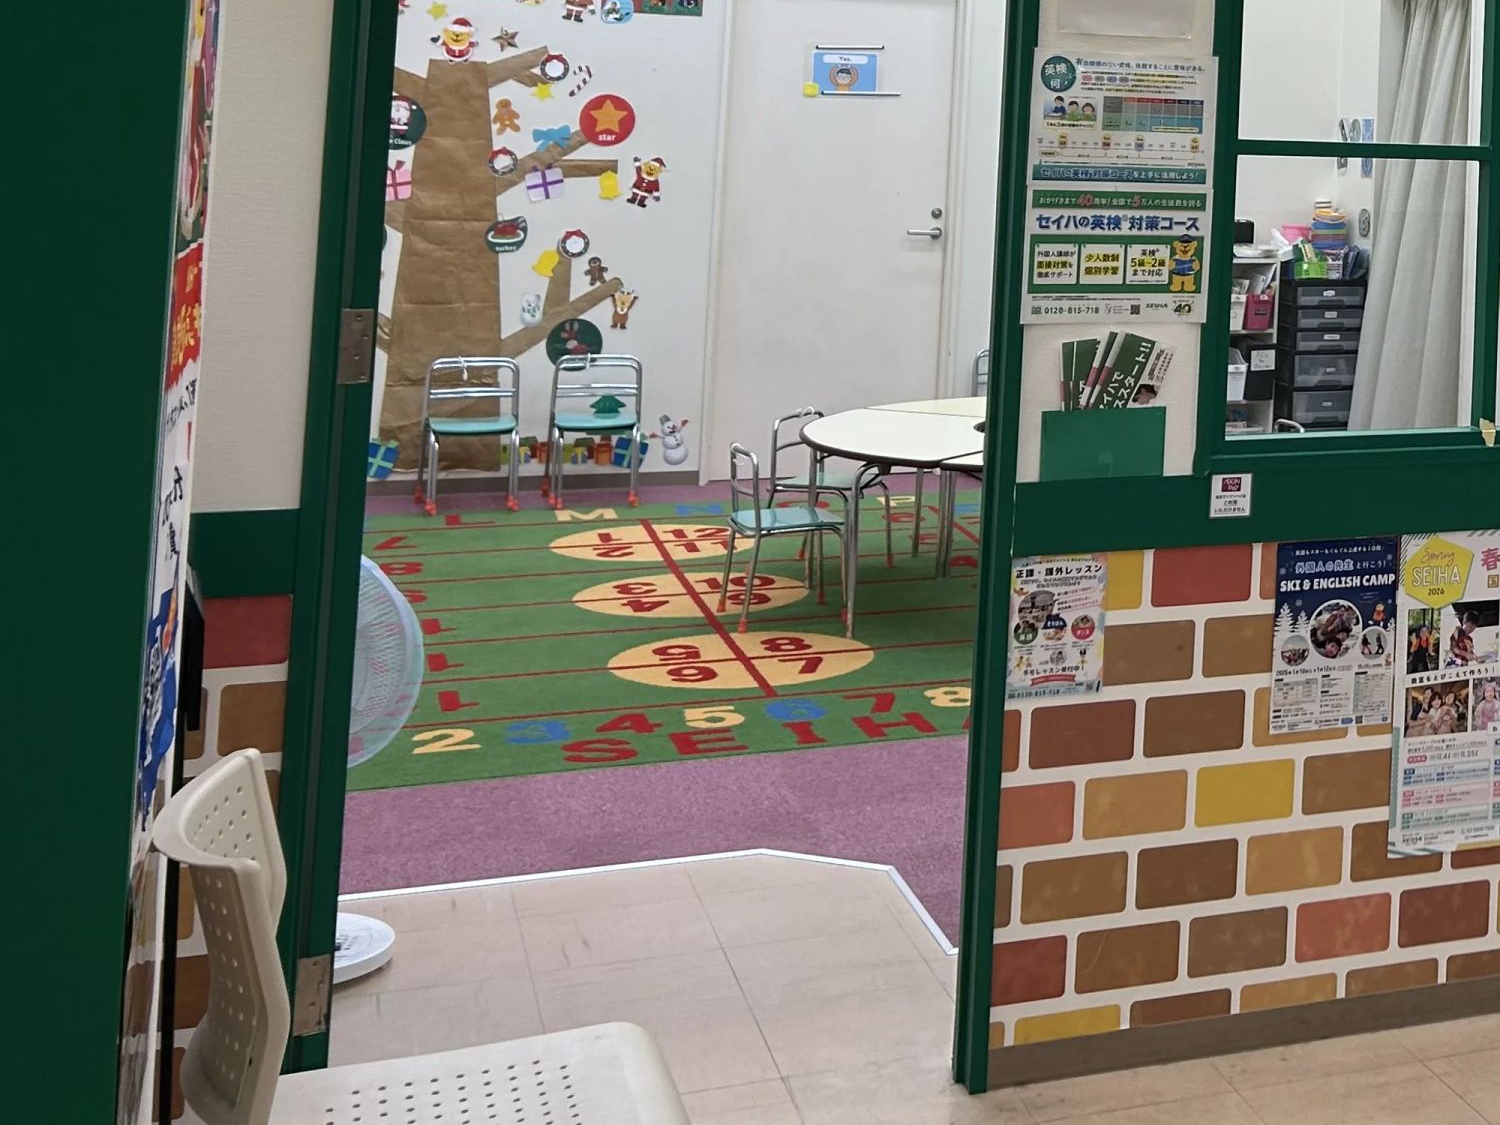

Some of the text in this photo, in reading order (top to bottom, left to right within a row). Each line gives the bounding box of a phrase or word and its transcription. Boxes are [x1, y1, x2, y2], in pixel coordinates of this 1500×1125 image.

[598, 133, 616, 141] star
[1085, 253, 1120, 262] 少人数制
[1037, 261, 1073, 269] 面接対策を
[1084, 266, 1119, 275] 個別学習
[1132, 269, 1163, 277] まで対応
[1044, 306, 1100, 315] 0120-815-718
[1420, 546, 1455, 567] Spring
[1412, 565, 1461, 587] SEIHA
[1280, 573, 1396, 593] SKI & ENGLISH CAMP
[1428, 587, 1445, 596] 2026
[411, 729, 482, 755] 2
[504, 720, 573, 745] 3
[595, 713, 664, 734] 4
[684, 706, 746, 728] 5
[765, 698, 827, 721] 6
[841, 693, 895, 712] 7
